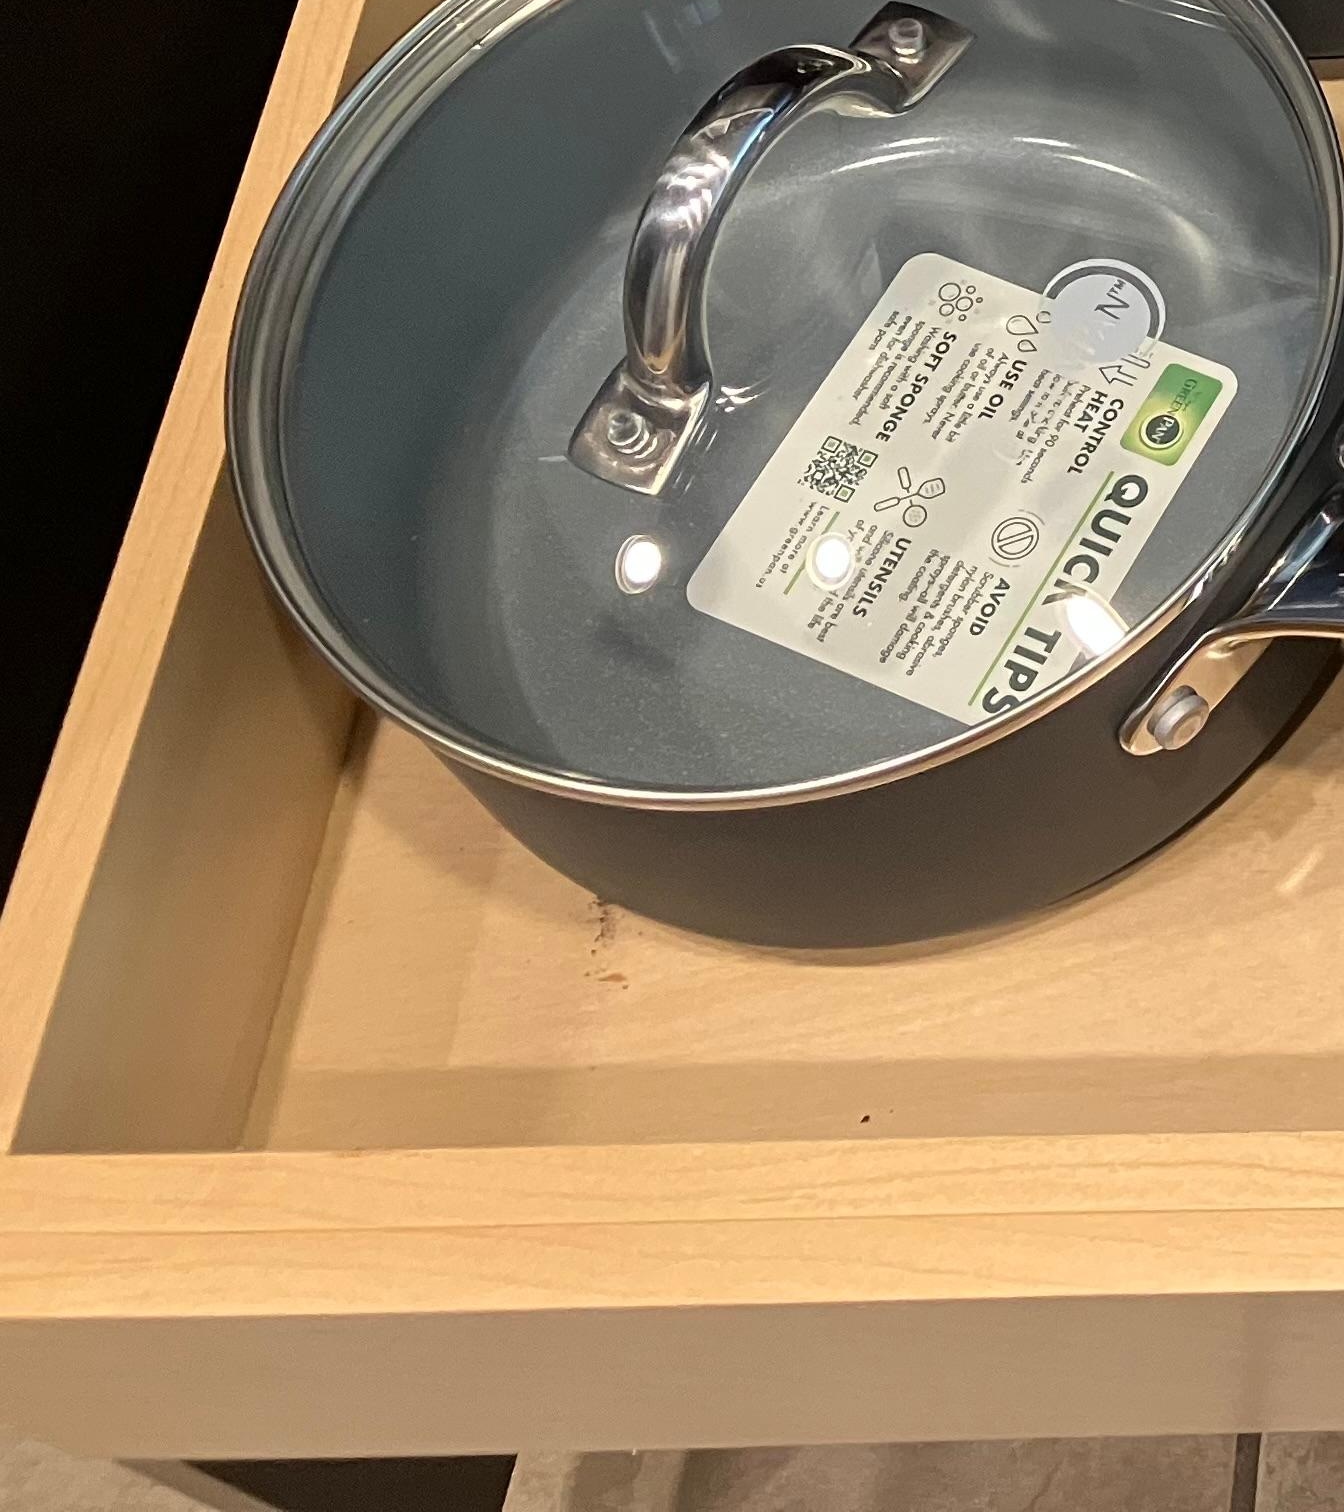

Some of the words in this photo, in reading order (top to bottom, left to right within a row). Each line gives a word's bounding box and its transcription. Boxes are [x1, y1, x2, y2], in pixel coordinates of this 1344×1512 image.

[923, 331, 957, 371] SOFT
[998, 359, 1027, 390] USE
[875, 373, 928, 441] SPONGE
[977, 393, 1003, 418] OIL
[1073, 390, 1108, 433] HEAT
[1044, 433, 1059, 447] 90
[1066, 398, 1124, 473] CONTROL
[852, 537, 911, 617] UTENSILS
[969, 577, 1010, 635] AVOID
[982, 627, 1062, 714] TIPS
